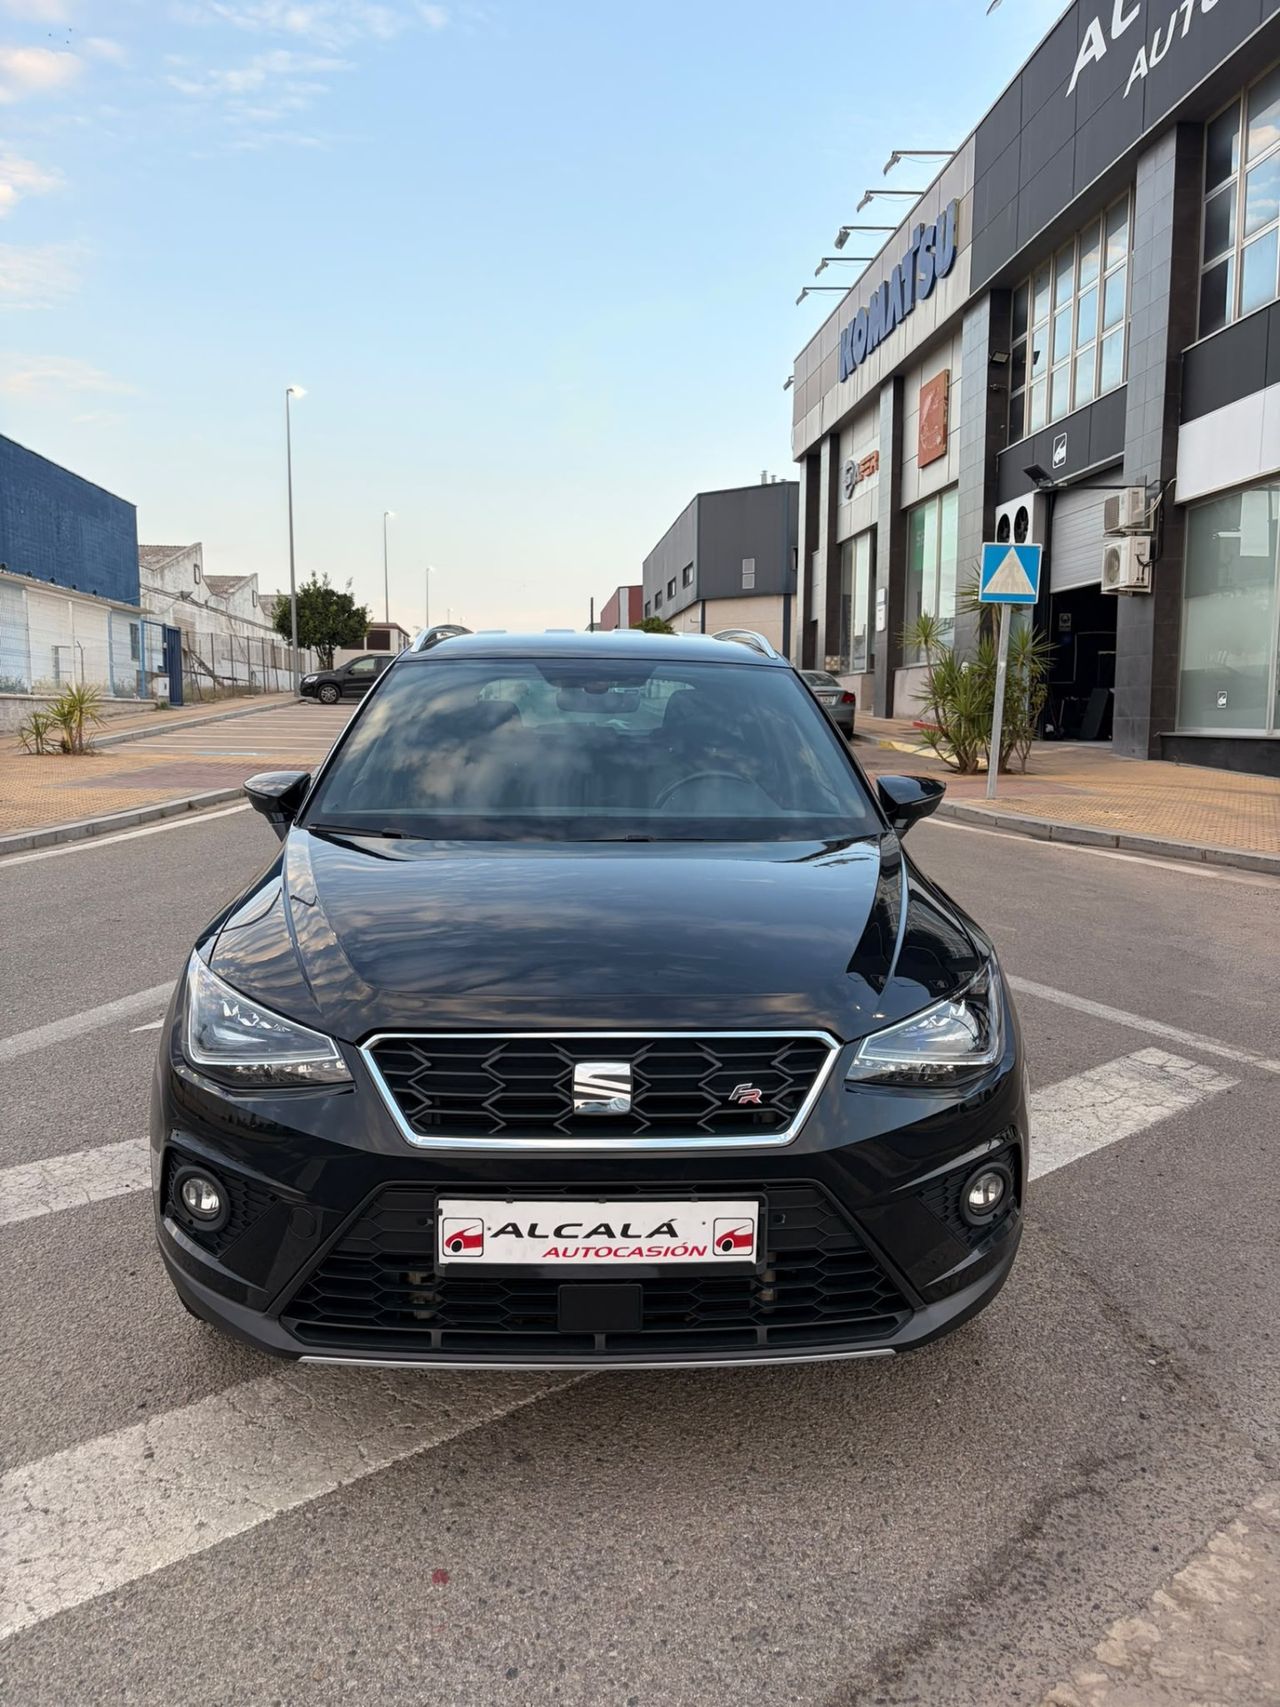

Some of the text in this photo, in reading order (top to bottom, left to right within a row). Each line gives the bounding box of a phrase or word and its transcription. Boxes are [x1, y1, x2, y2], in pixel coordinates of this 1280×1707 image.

[839, 198, 958, 383] KOMATSU
[728, 1082, 762, 1104] FR
[489, 1218, 679, 1239] ALCALÁ
[541, 1242, 708, 1258] AUTOCASIÓN
